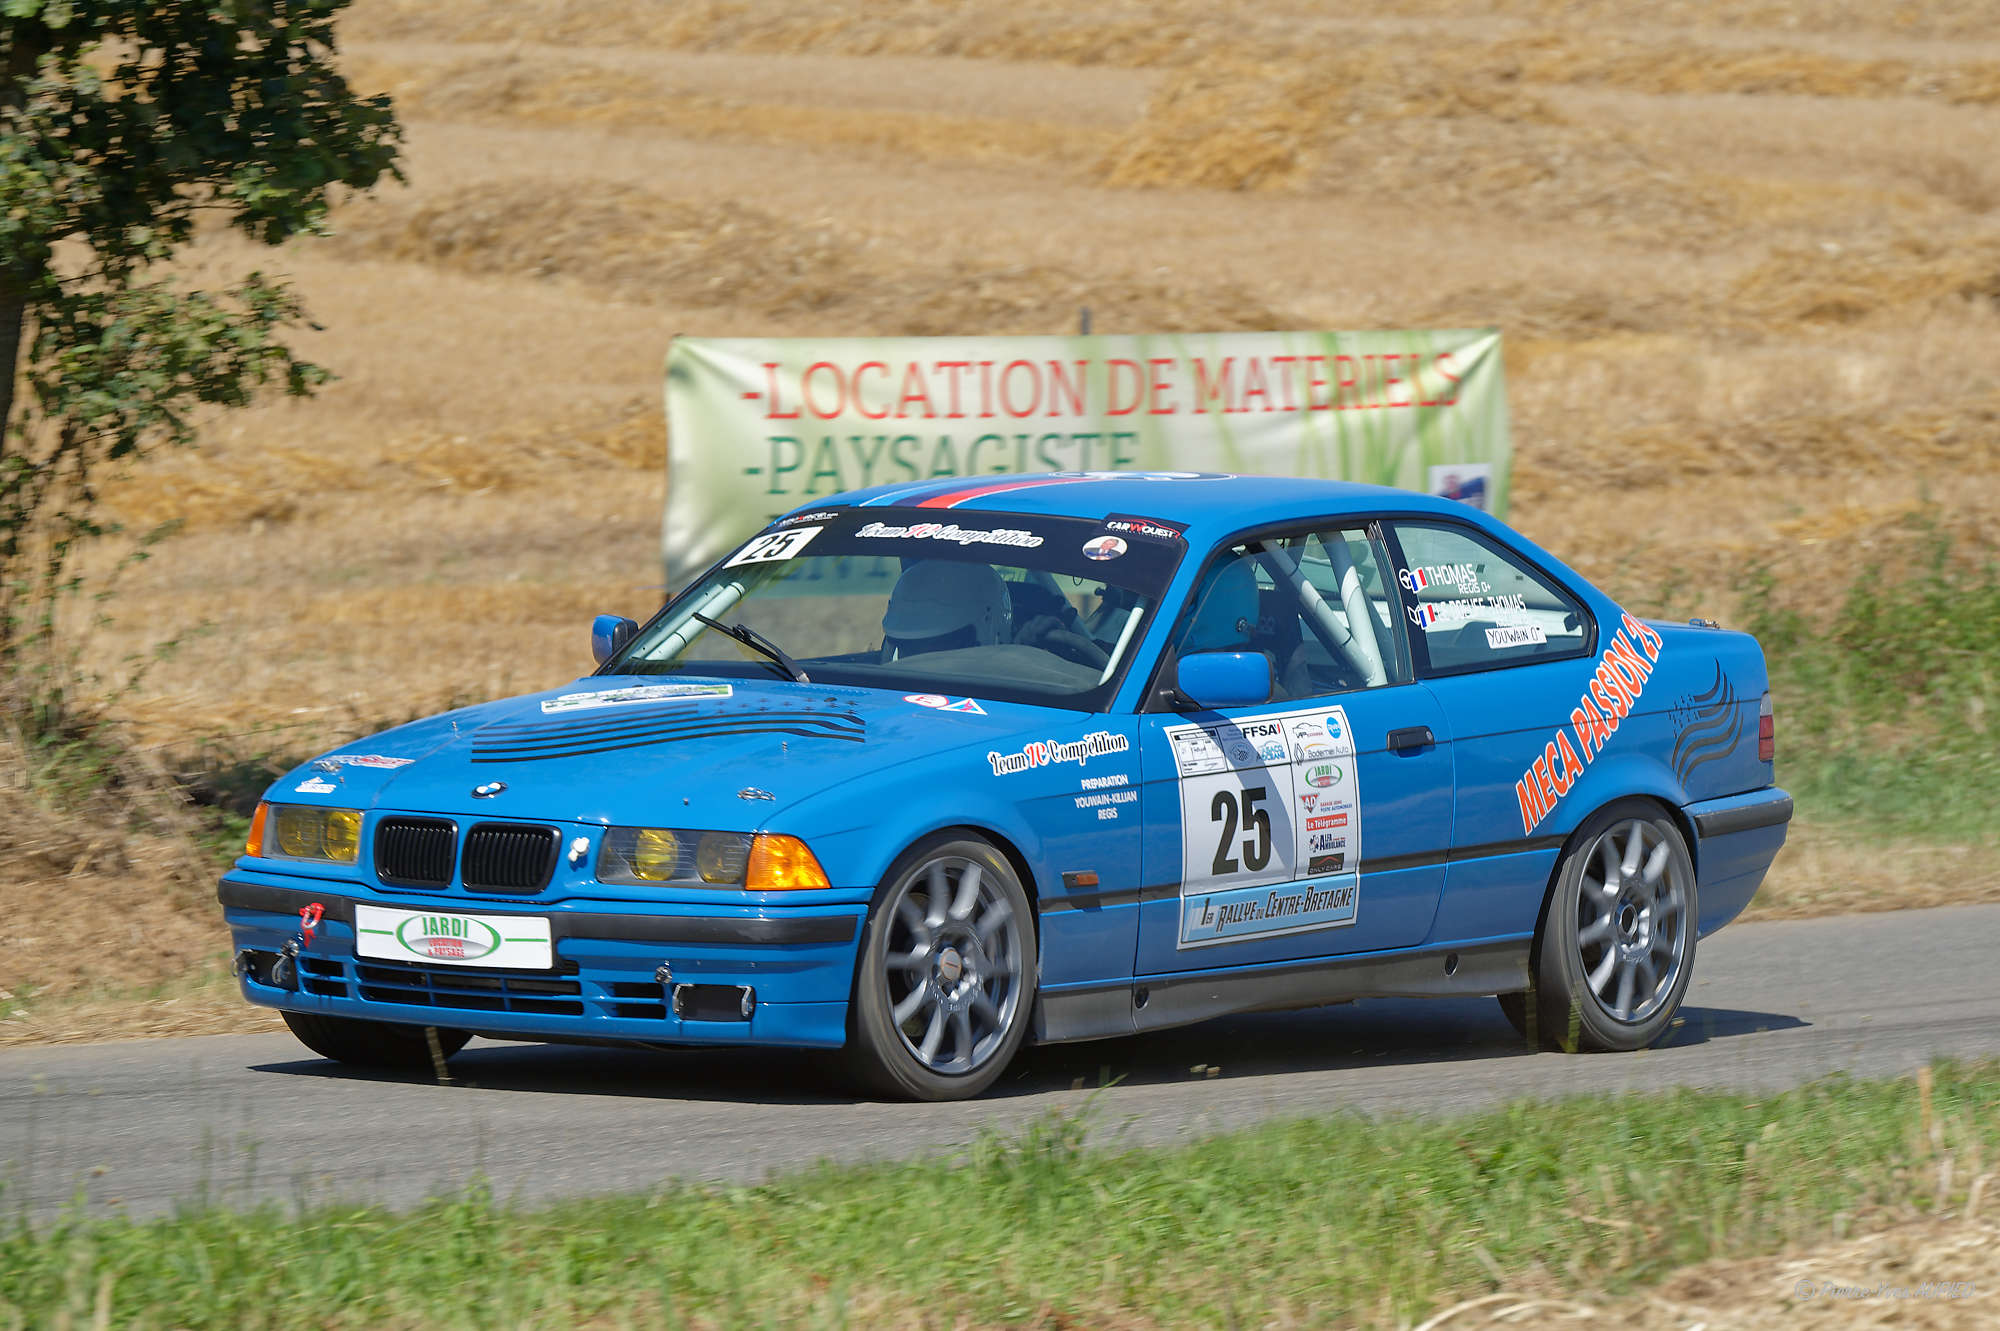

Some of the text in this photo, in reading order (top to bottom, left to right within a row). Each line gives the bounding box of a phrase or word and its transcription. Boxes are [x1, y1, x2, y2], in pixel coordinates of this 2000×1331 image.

[1104, 357, 1176, 416] DE
[1191, 352, 1462, 415] MATERIELS
[741, 531, 803, 561] 25
[1425, 563, 1477, 585] THOMAS
[1242, 723, 1278, 739] FFSA
[1515, 729, 1584, 836] MECA
[1570, 628, 1655, 764] PASSION
[988, 752, 1027, 776] Team
[1081, 774, 1129, 790] PREPARATION
[1098, 807, 1118, 820] REGIS
[1211, 786, 1271, 876] 25
[1216, 901, 1258, 932] RALLYE
[1265, 886, 1354, 919] CENTRE-BRETAGNE
[422, 916, 468, 939] JARDI
